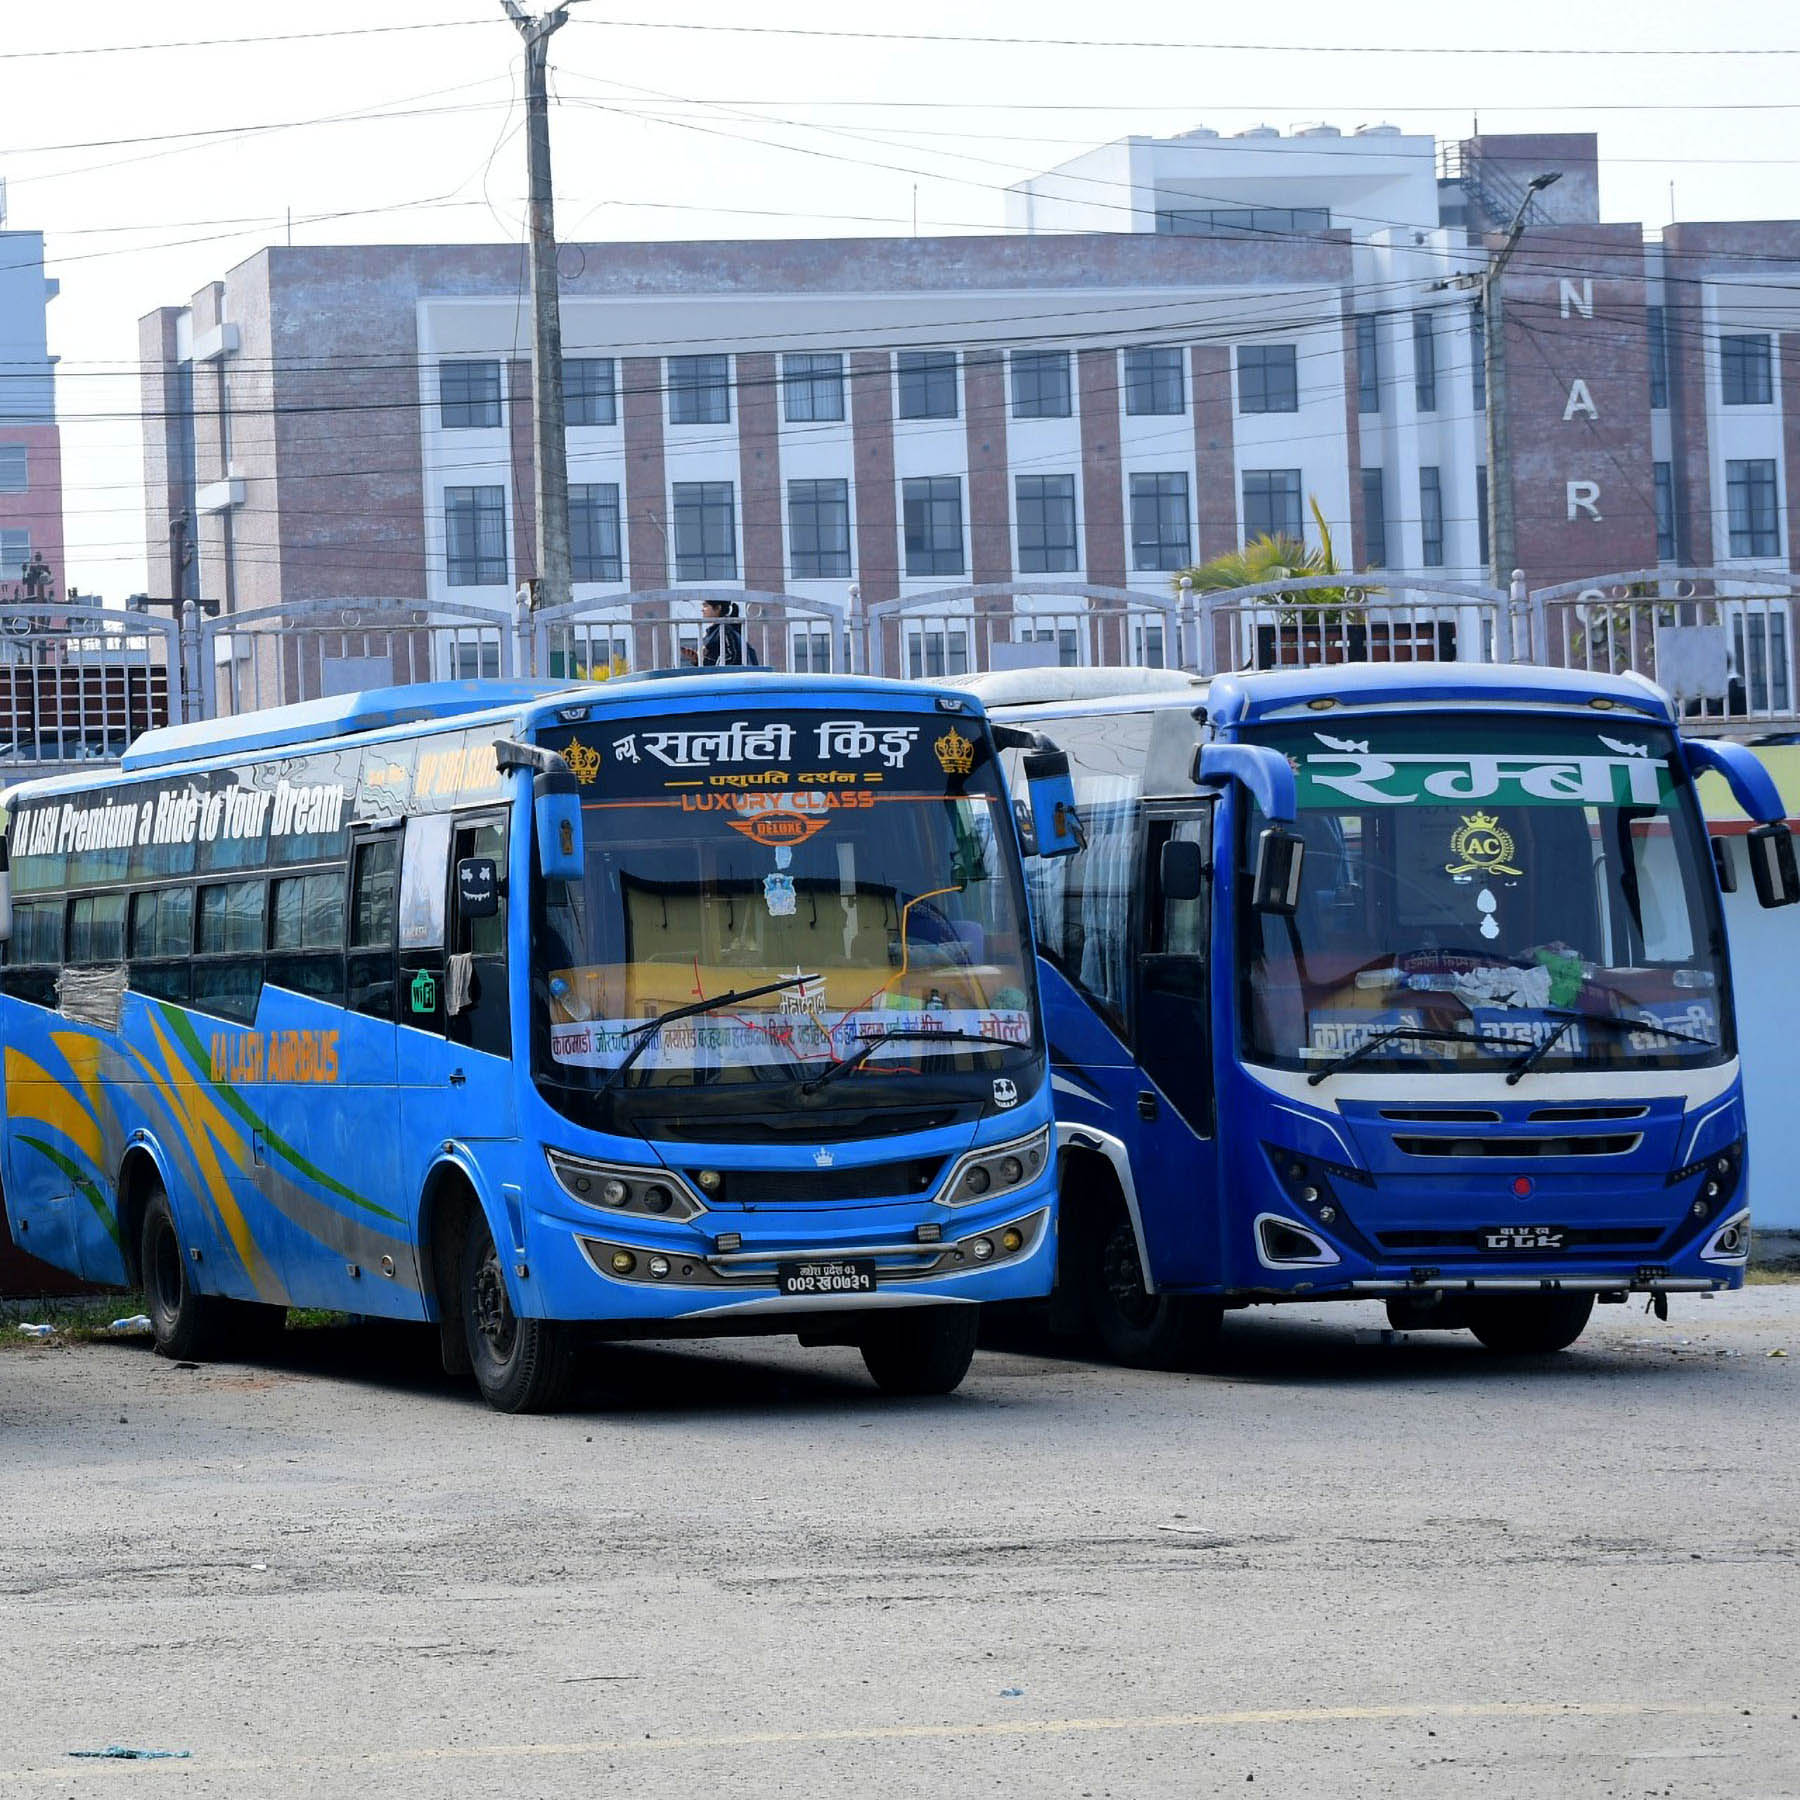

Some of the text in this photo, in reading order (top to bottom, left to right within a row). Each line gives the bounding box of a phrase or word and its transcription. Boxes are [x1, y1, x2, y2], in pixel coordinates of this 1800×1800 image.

[641, 722, 798, 767] सर्लाही
[709, 770, 858, 788] पशुपति दर्शन
[682, 791, 875, 812] LUXURY CLASS
[57, 797, 139, 854] Premium
[138, 800, 154, 845] a
[152, 790, 198, 843] Ride
[199, 791, 221, 842] to
[223, 785, 272, 839] Your
[270, 779, 344, 836] Dream
[757, 822, 802, 836] DELUXE
[1467, 838, 1500, 855] AC
[267, 1029, 339, 1083] AIRBUS
